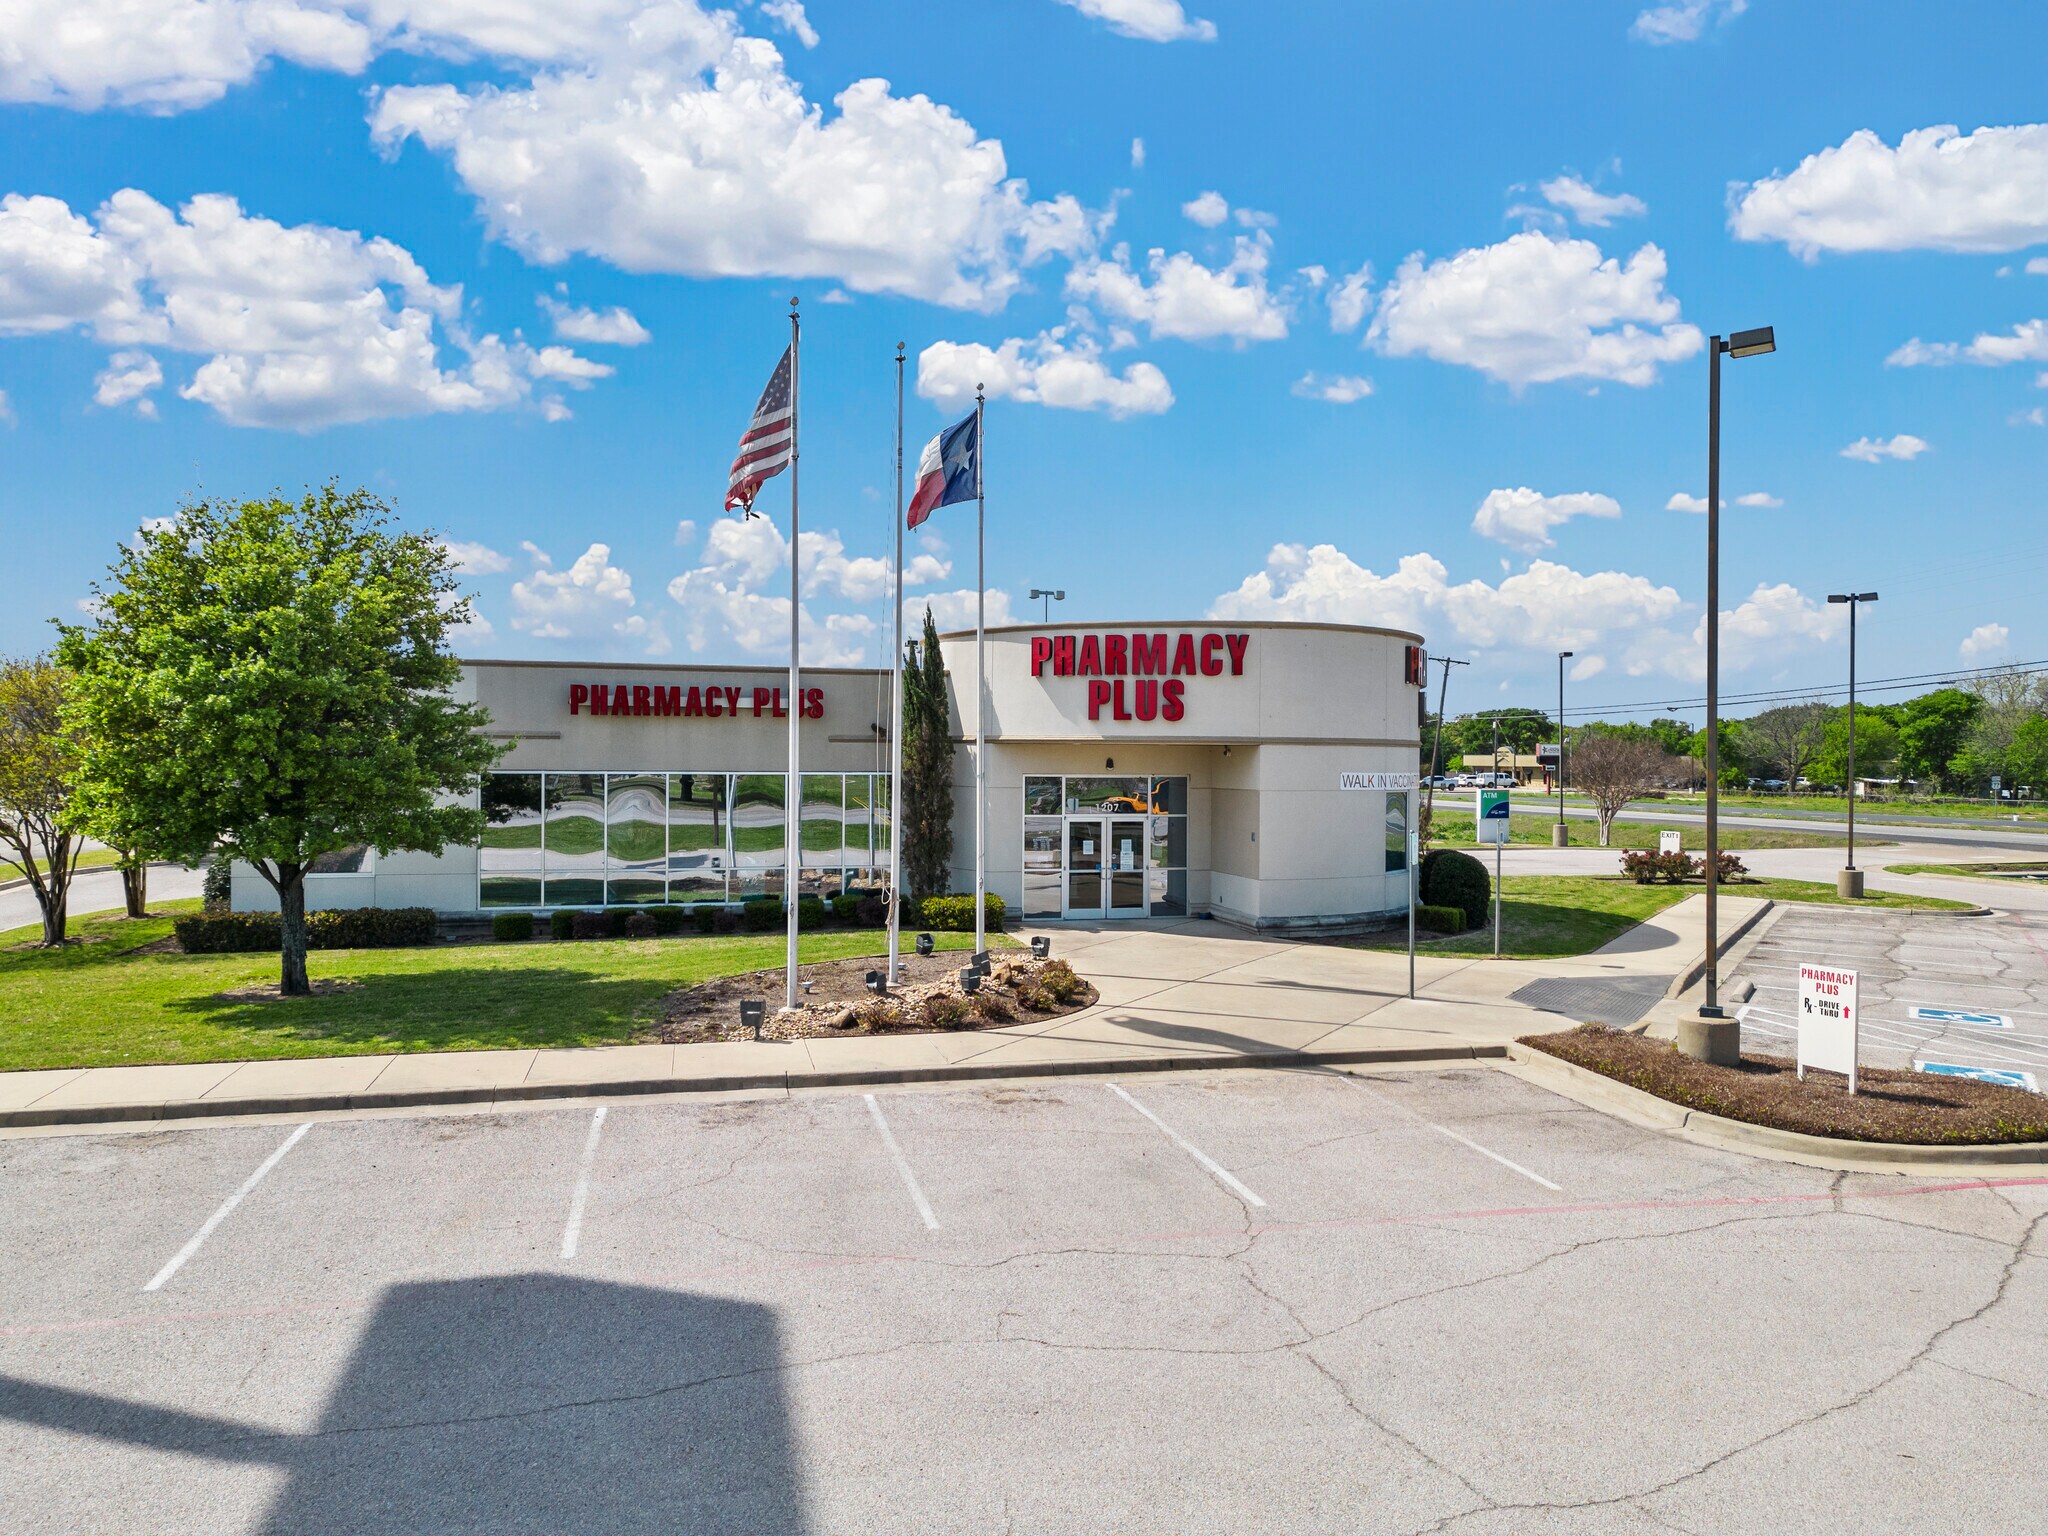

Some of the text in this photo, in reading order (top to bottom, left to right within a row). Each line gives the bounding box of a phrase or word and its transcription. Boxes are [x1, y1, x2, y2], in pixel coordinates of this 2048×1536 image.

[1030, 633, 1250, 677] PHARMACY
[570, 684, 742, 718] PHARMACY
[1088, 679, 1185, 722] PLUS
[1342, 774, 1375, 788] WALK
[1377, 774, 1387, 788] IN
[1096, 802, 1119, 812] 1207
[1801, 968, 1854, 986] PHARMACY
[1815, 982, 1839, 996] PLUS
[1818, 1000, 1840, 1010] DRIVE
[1820, 1008, 1839, 1018] THRU
